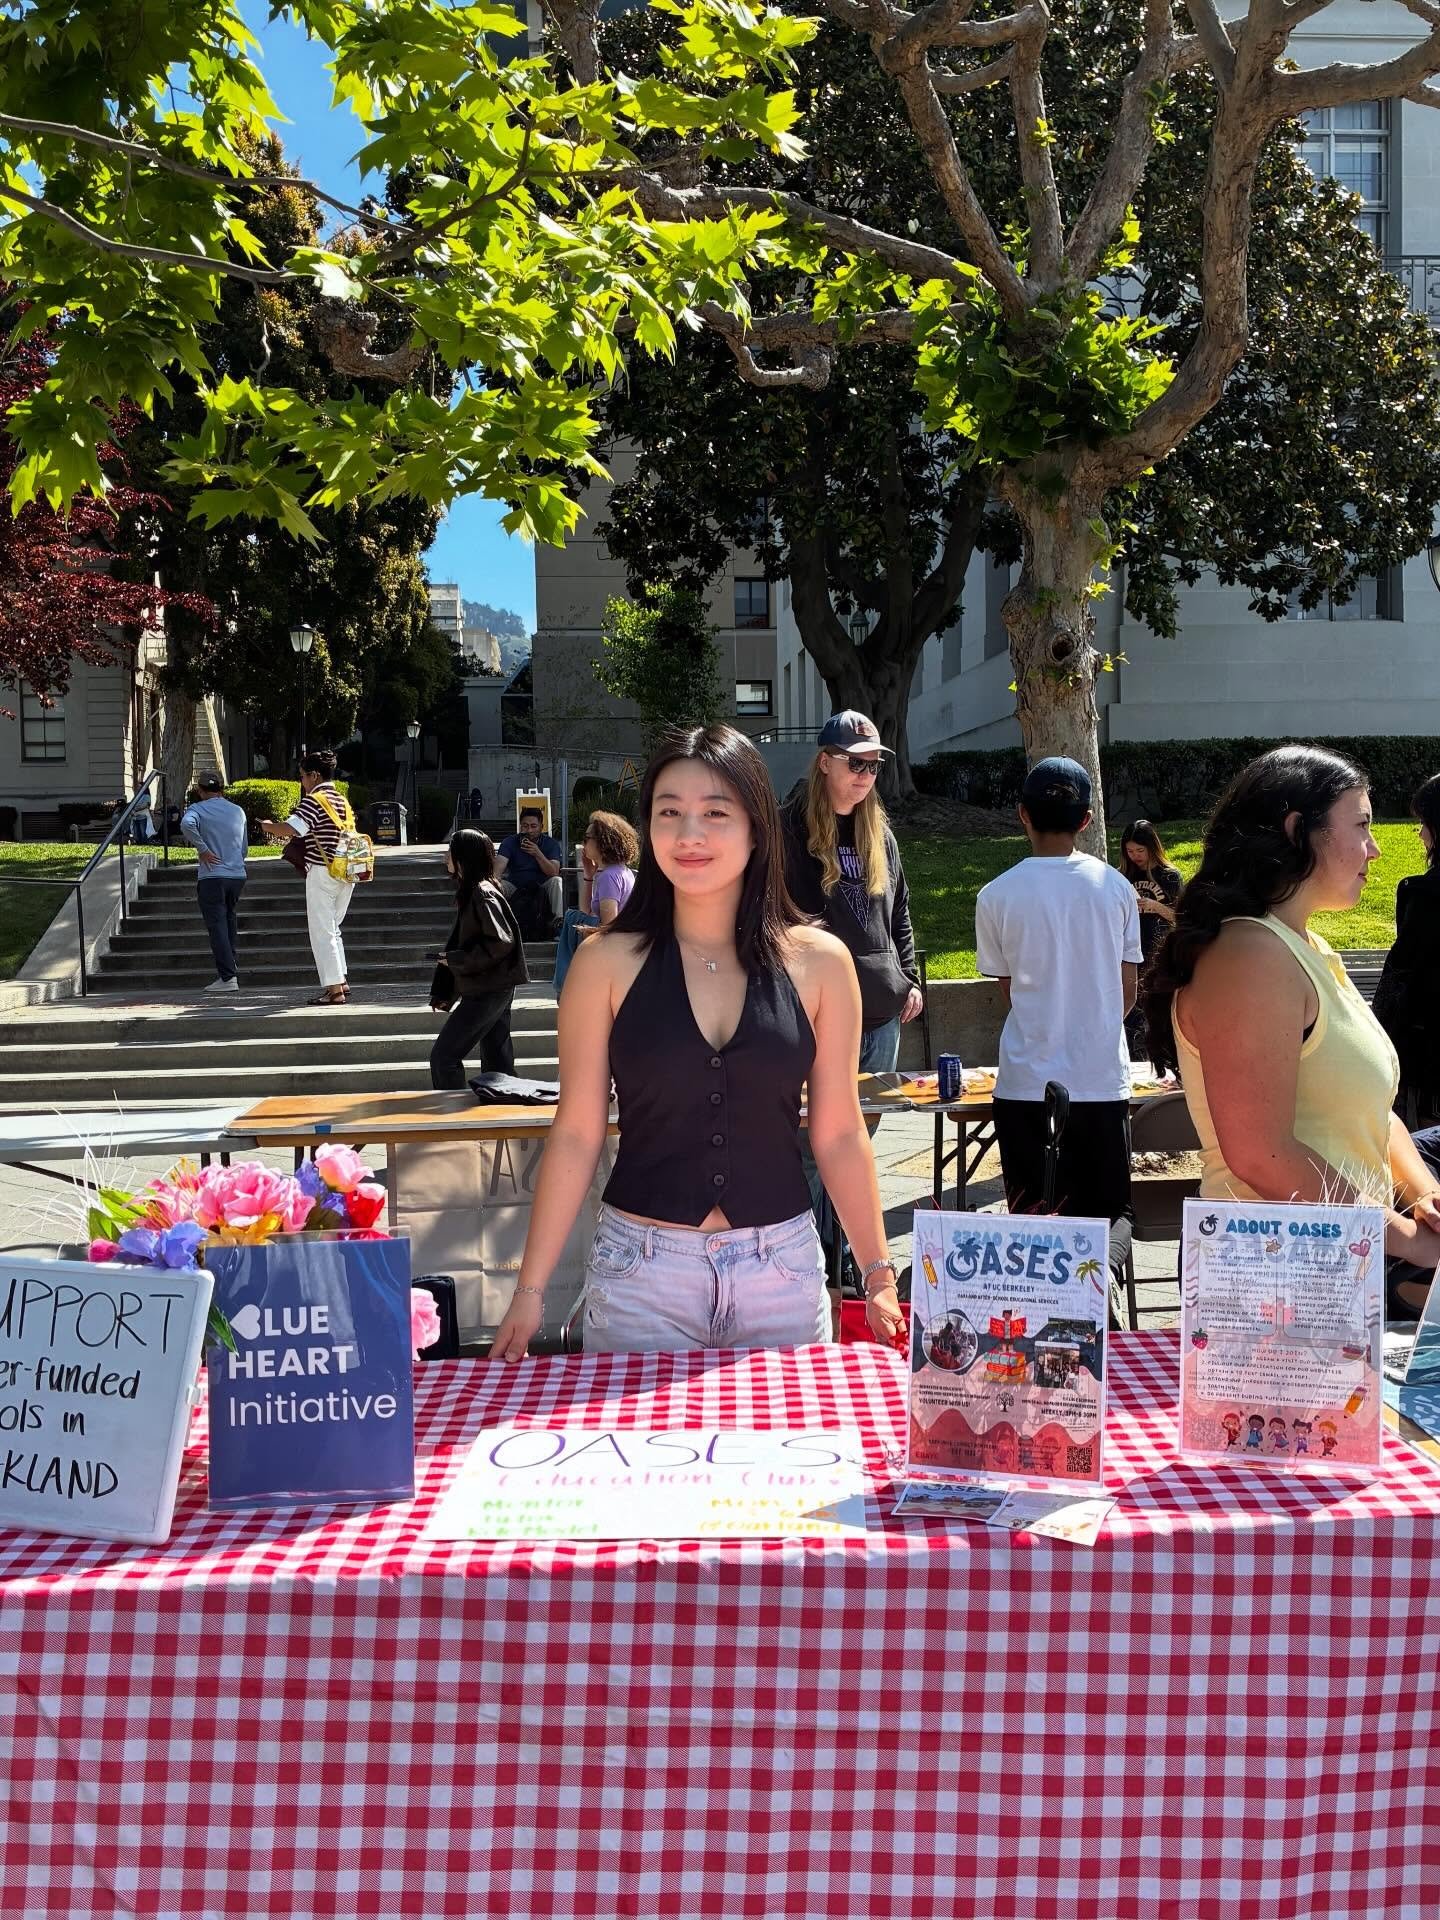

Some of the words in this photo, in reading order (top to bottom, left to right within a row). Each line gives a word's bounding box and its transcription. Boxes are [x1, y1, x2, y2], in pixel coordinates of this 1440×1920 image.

[1226, 1219, 1282, 1235] ABOUT
[1289, 1222, 1342, 1238] OASES
[992, 1283, 1001, 1291] UC
[1002, 1284, 1035, 1293] BERKELEY
[0, 1356, 141, 1399] er-funded
[228, 1346, 354, 1379] HEART
[63, 1411, 84, 1435] in
[229, 1389, 398, 1427] Initiative
[489, 1431, 842, 1470] OASES
